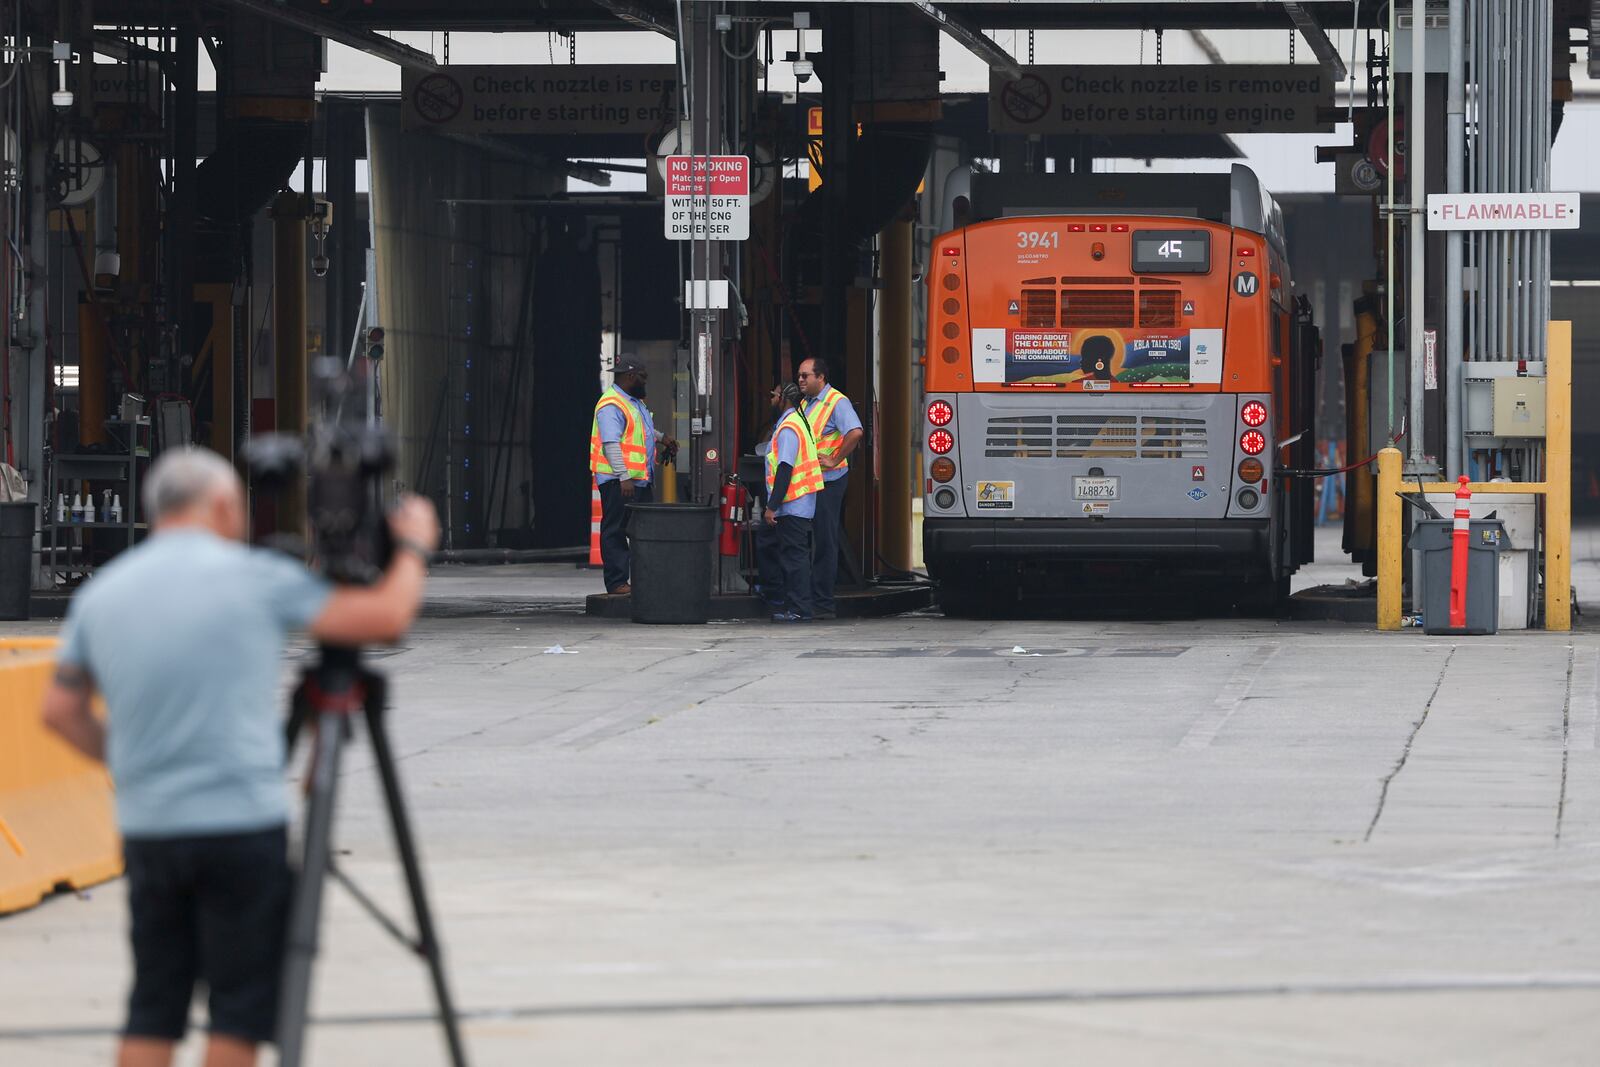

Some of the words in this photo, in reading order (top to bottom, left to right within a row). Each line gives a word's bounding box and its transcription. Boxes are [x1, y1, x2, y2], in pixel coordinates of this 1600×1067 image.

[473, 76, 535, 93] Check
[543, 76, 608, 93] nozzle
[616, 76, 633, 93] is
[1061, 76, 1123, 94] Check
[1131, 76, 1198, 94] nozzle
[1205, 76, 1221, 94] is
[1228, 76, 1320, 94] removed
[473, 104, 541, 121] before
[547, 104, 629, 125] starting
[1061, 104, 1129, 121] before
[1136, 104, 1217, 126] starting
[1225, 105, 1296, 126] engine
[672, 161, 688, 171] NO
[692, 161, 743, 171] SMOKING
[719, 174, 741, 183] Open
[712, 198, 723, 207] 50
[726, 198, 741, 207] FT.
[672, 212, 685, 220] OF
[688, 212, 707, 220] THE
[710, 212, 732, 220] CNG
[1442, 203, 1567, 220] FLAMMABLE
[1017, 231, 1058, 249] 3941
[1158, 240, 1182, 258] 45
[1237, 275, 1255, 293] M
[1152, 340, 1167, 348] TALK
[1190, 490, 1205, 498] CNG
